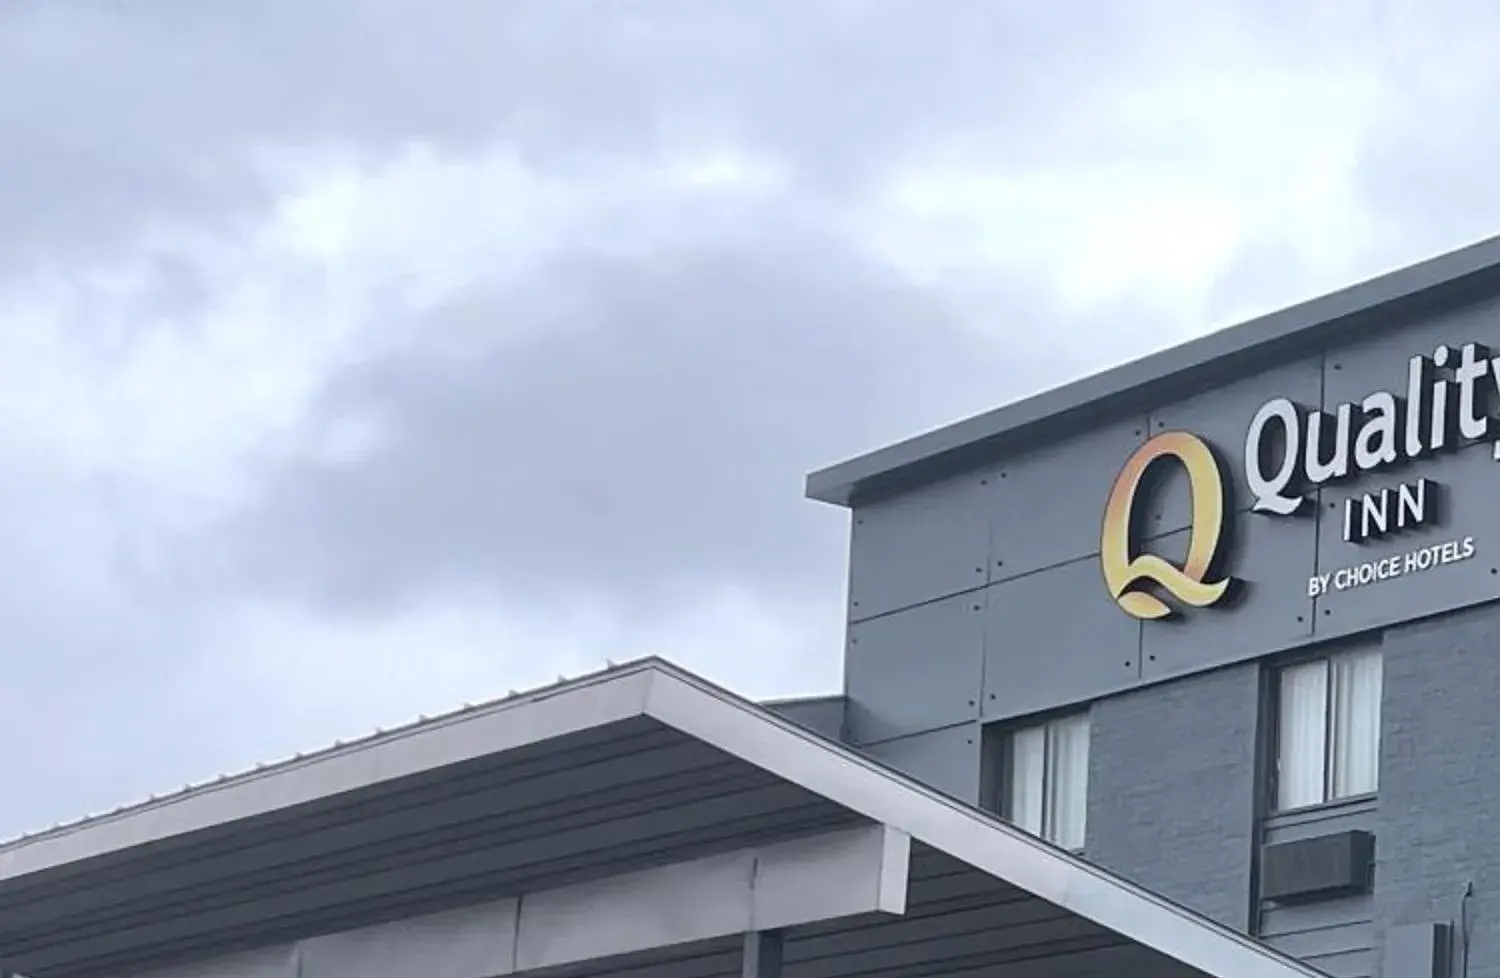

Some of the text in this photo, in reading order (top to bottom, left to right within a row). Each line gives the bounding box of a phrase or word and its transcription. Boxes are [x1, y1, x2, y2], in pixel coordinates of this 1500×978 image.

[1101, 430, 1231, 619] Q
[1343, 477, 1426, 542] INN
[1308, 536, 1475, 597] BY CHOICE HOTELS
